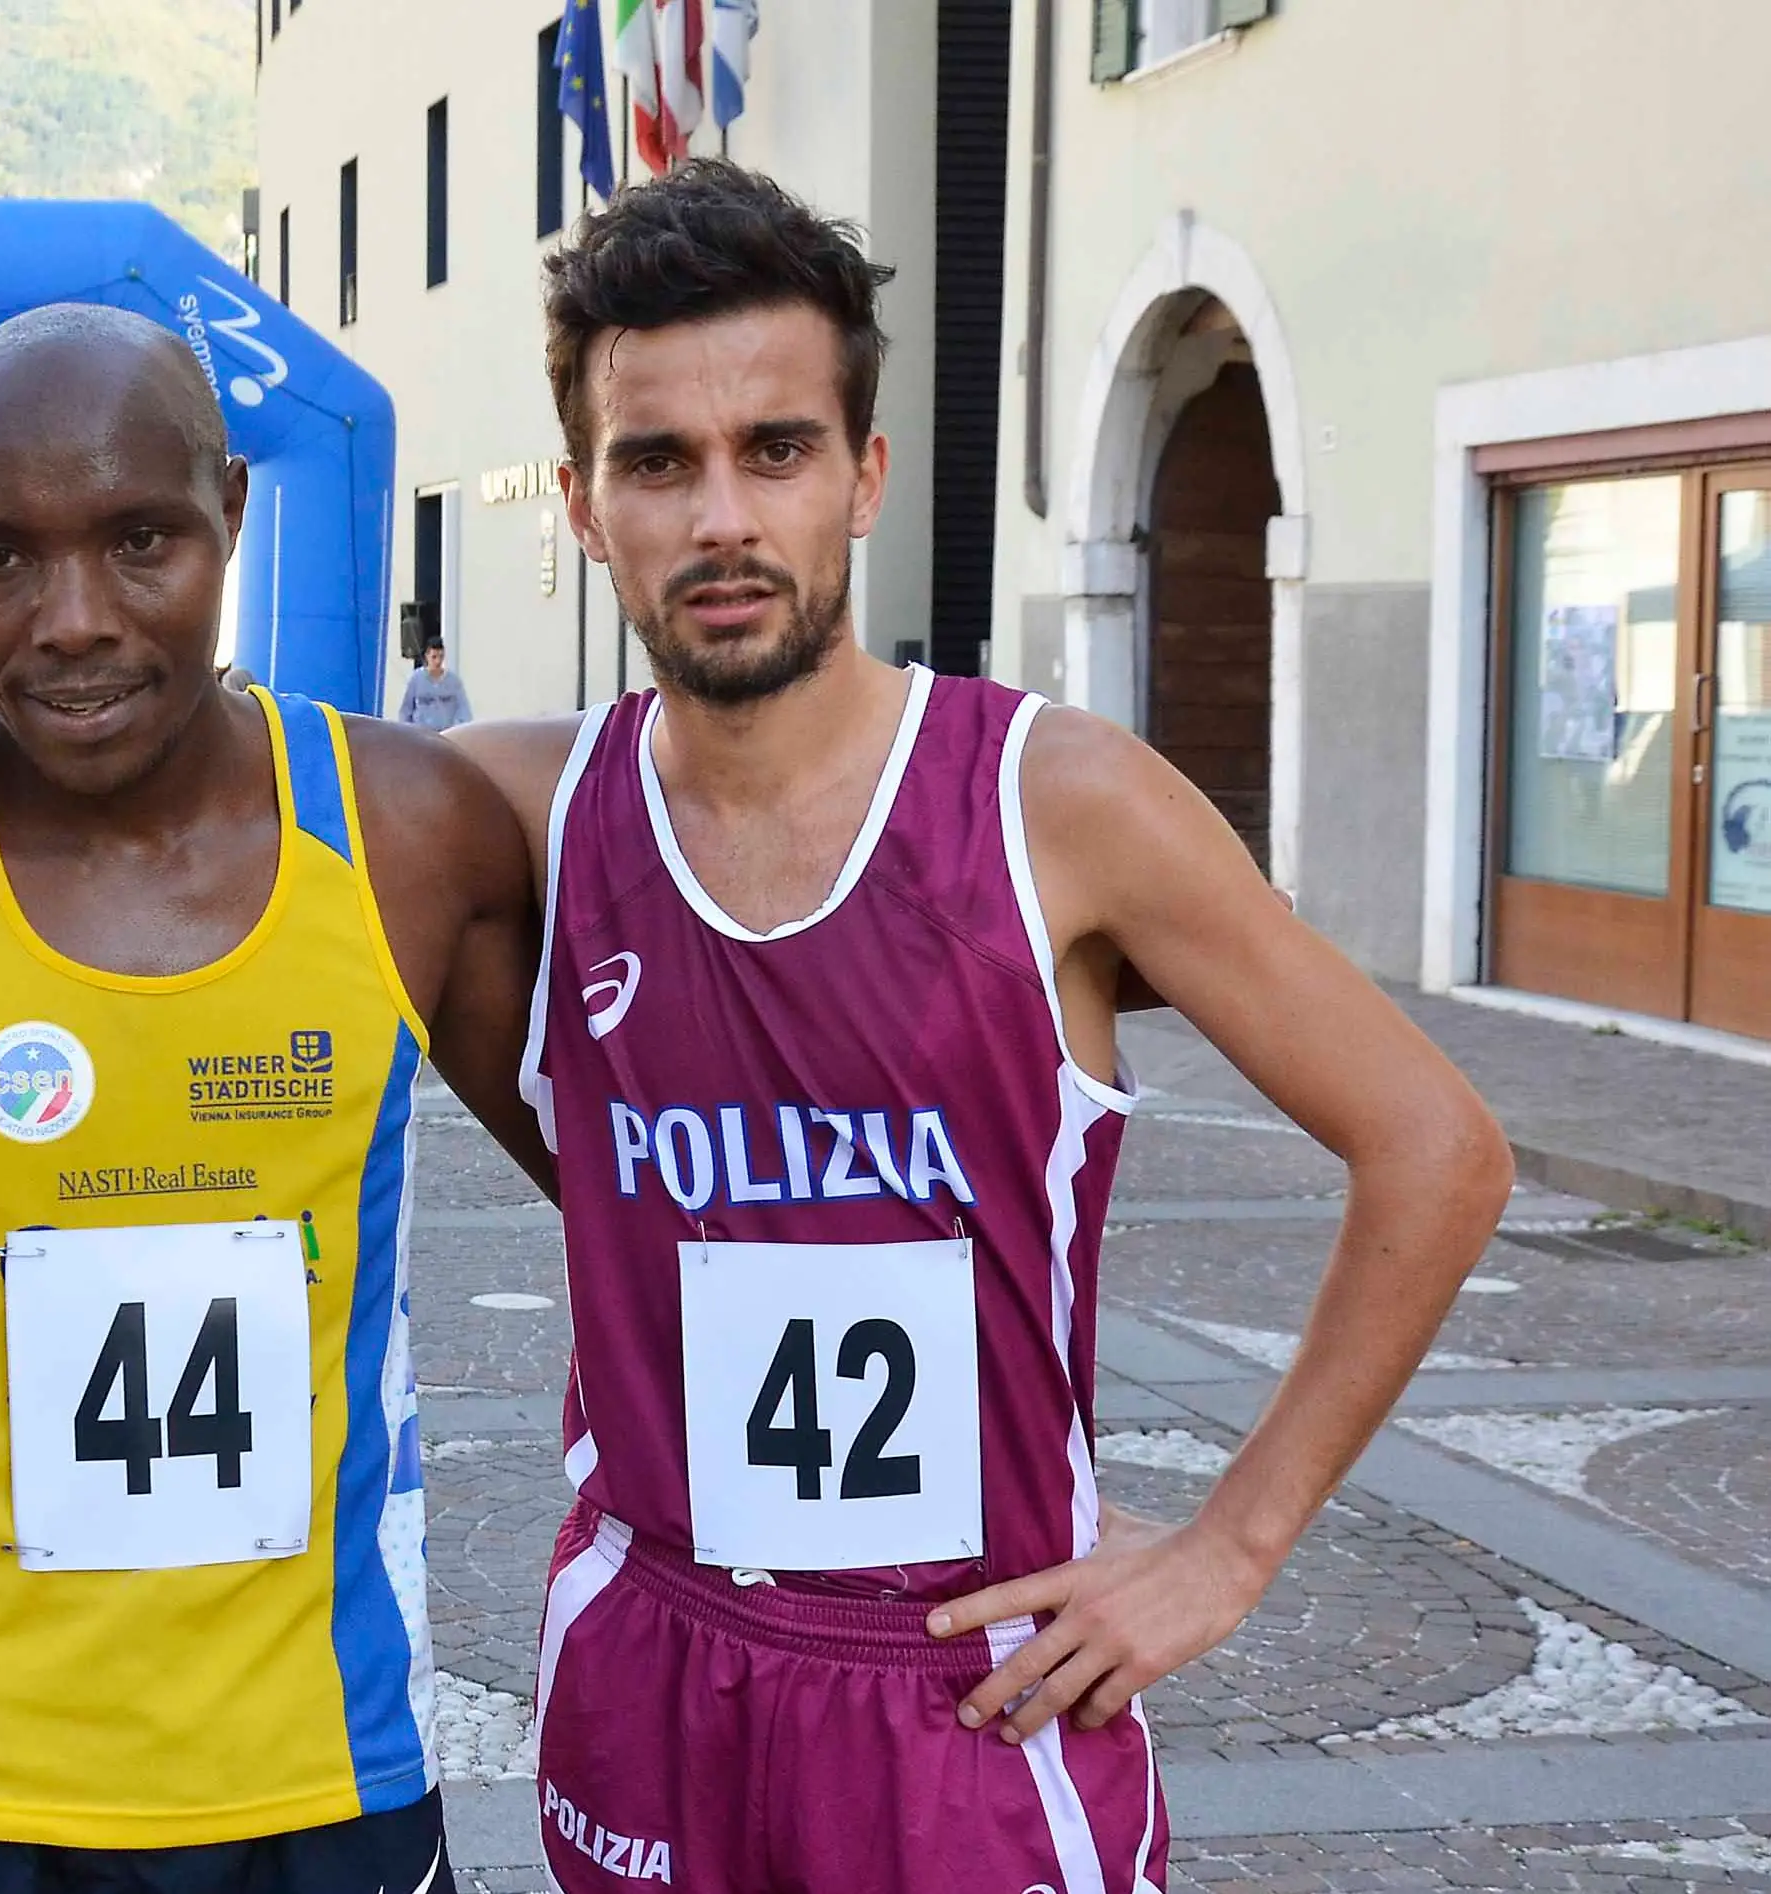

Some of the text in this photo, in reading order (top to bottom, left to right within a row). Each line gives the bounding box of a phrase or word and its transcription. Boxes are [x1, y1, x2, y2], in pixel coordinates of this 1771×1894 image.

[188, 1055, 285, 1076] WIENER
[189, 1078, 333, 1101] STÄDTISCHE
[194, 1163, 256, 1186] Estate
[608, 1100, 977, 1212] POLIZIA
[74, 1297, 252, 1495] 44
[747, 1319, 921, 1500] 42
[543, 1778, 671, 1885] POLIZIA
